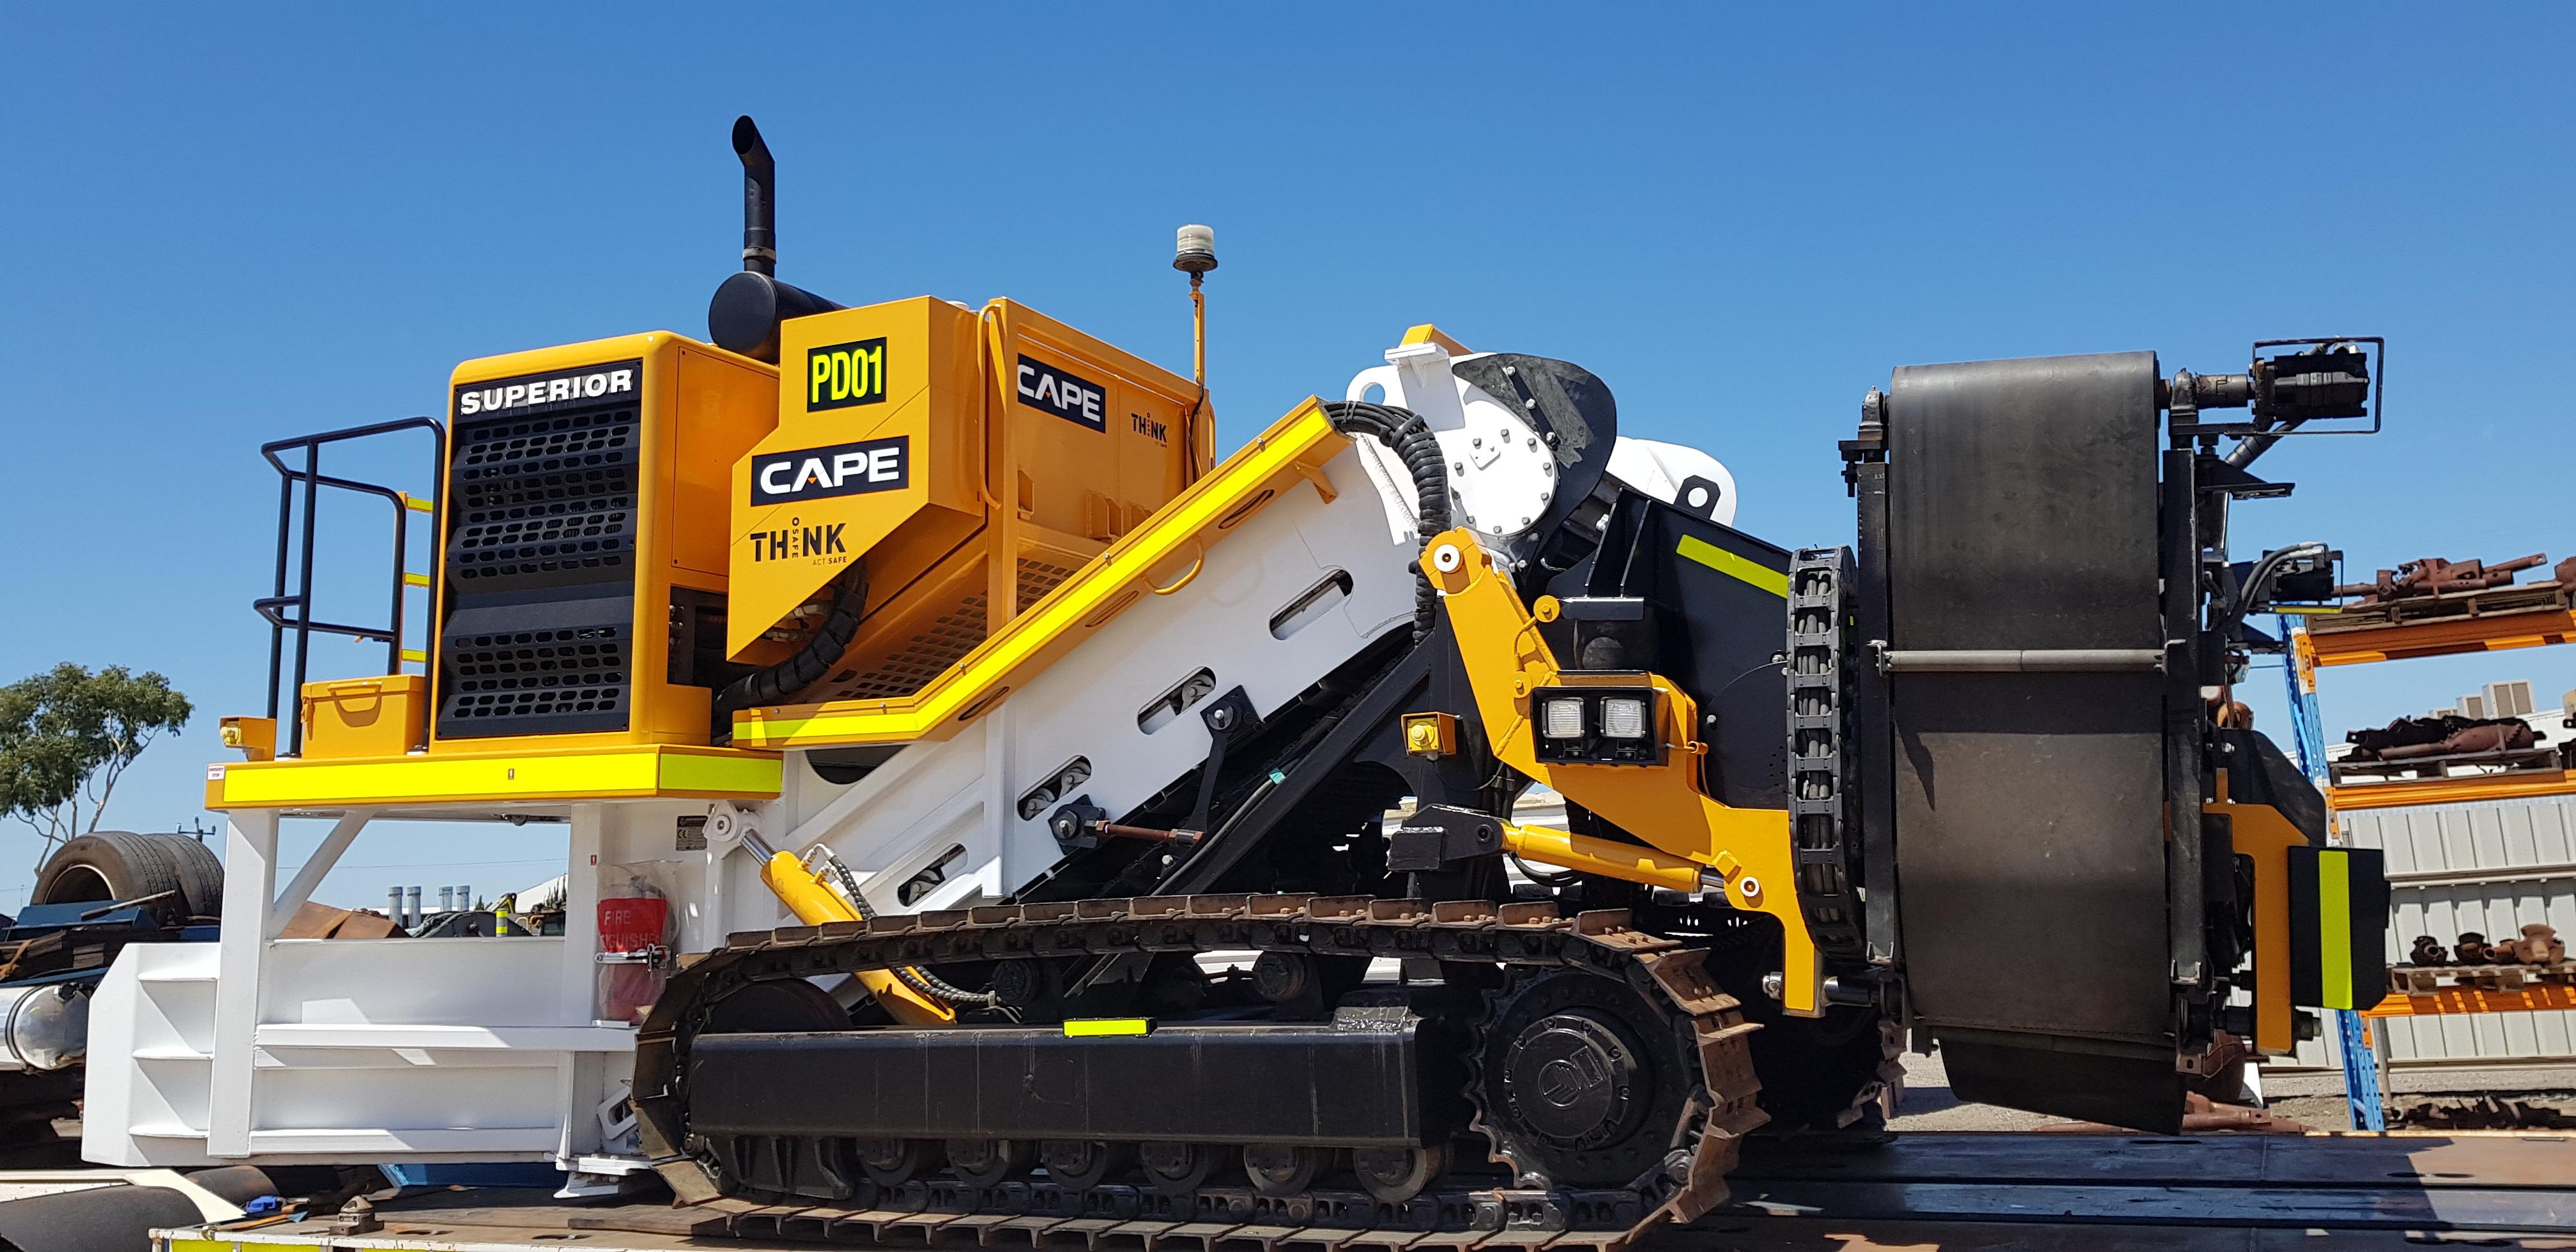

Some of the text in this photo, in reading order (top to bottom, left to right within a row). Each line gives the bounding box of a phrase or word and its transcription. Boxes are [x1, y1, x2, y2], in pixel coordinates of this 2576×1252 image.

[461, 369, 633, 415] SUPERIOR
[811, 345, 882, 403] PD01
[1017, 364, 1101, 423] CAPE
[760, 447, 900, 494] CAPE
[812, 556, 847, 567] ACT SAFE
[604, 910, 631, 926] FIRE
